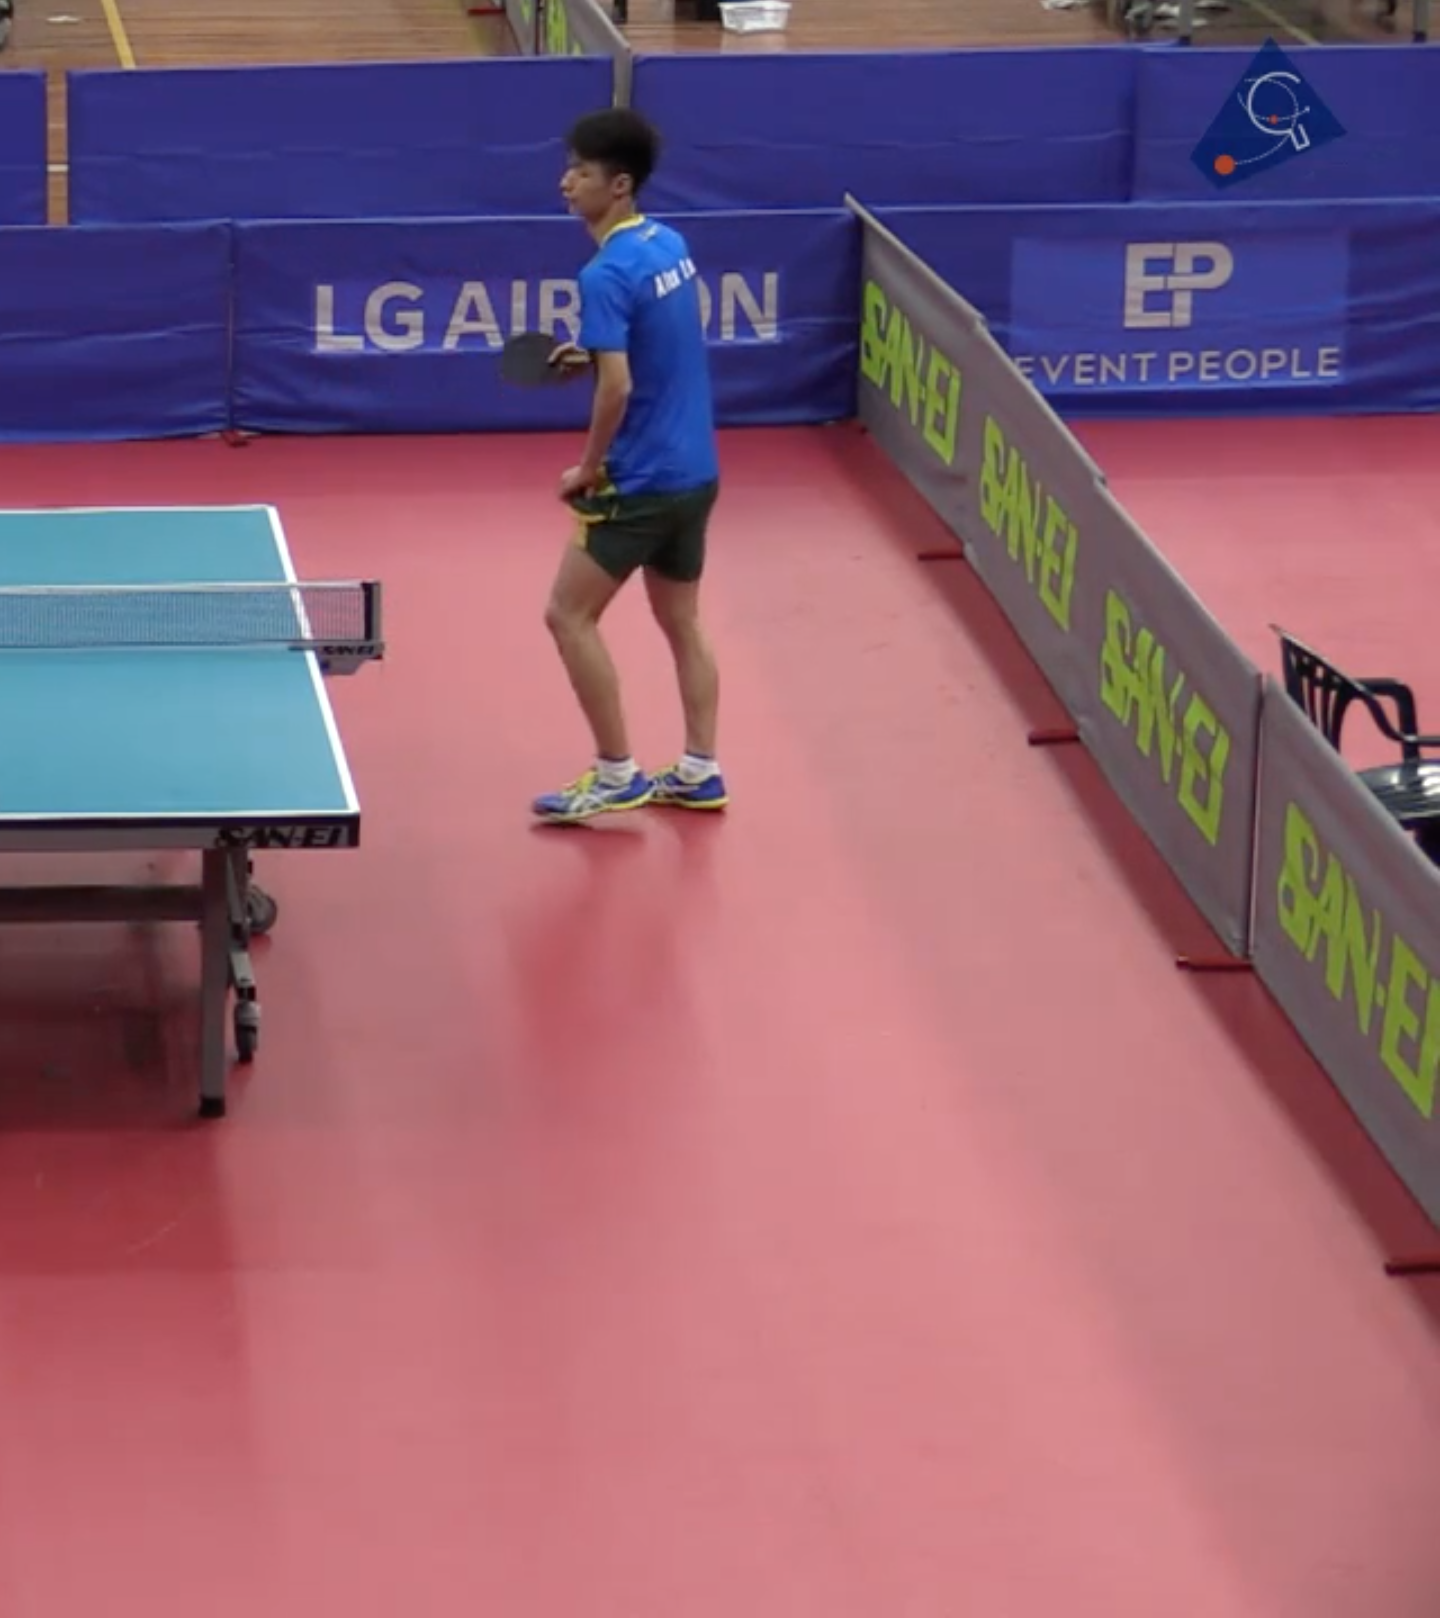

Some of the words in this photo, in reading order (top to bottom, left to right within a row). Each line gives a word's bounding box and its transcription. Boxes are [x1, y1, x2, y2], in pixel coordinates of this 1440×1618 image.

[315, 280, 425, 352] LG
[442, 271, 779, 351] AIRN
[1123, 241, 1234, 328] EP
[1015, 351, 1157, 386] EVENT
[1168, 346, 1341, 383] PEOPLE
